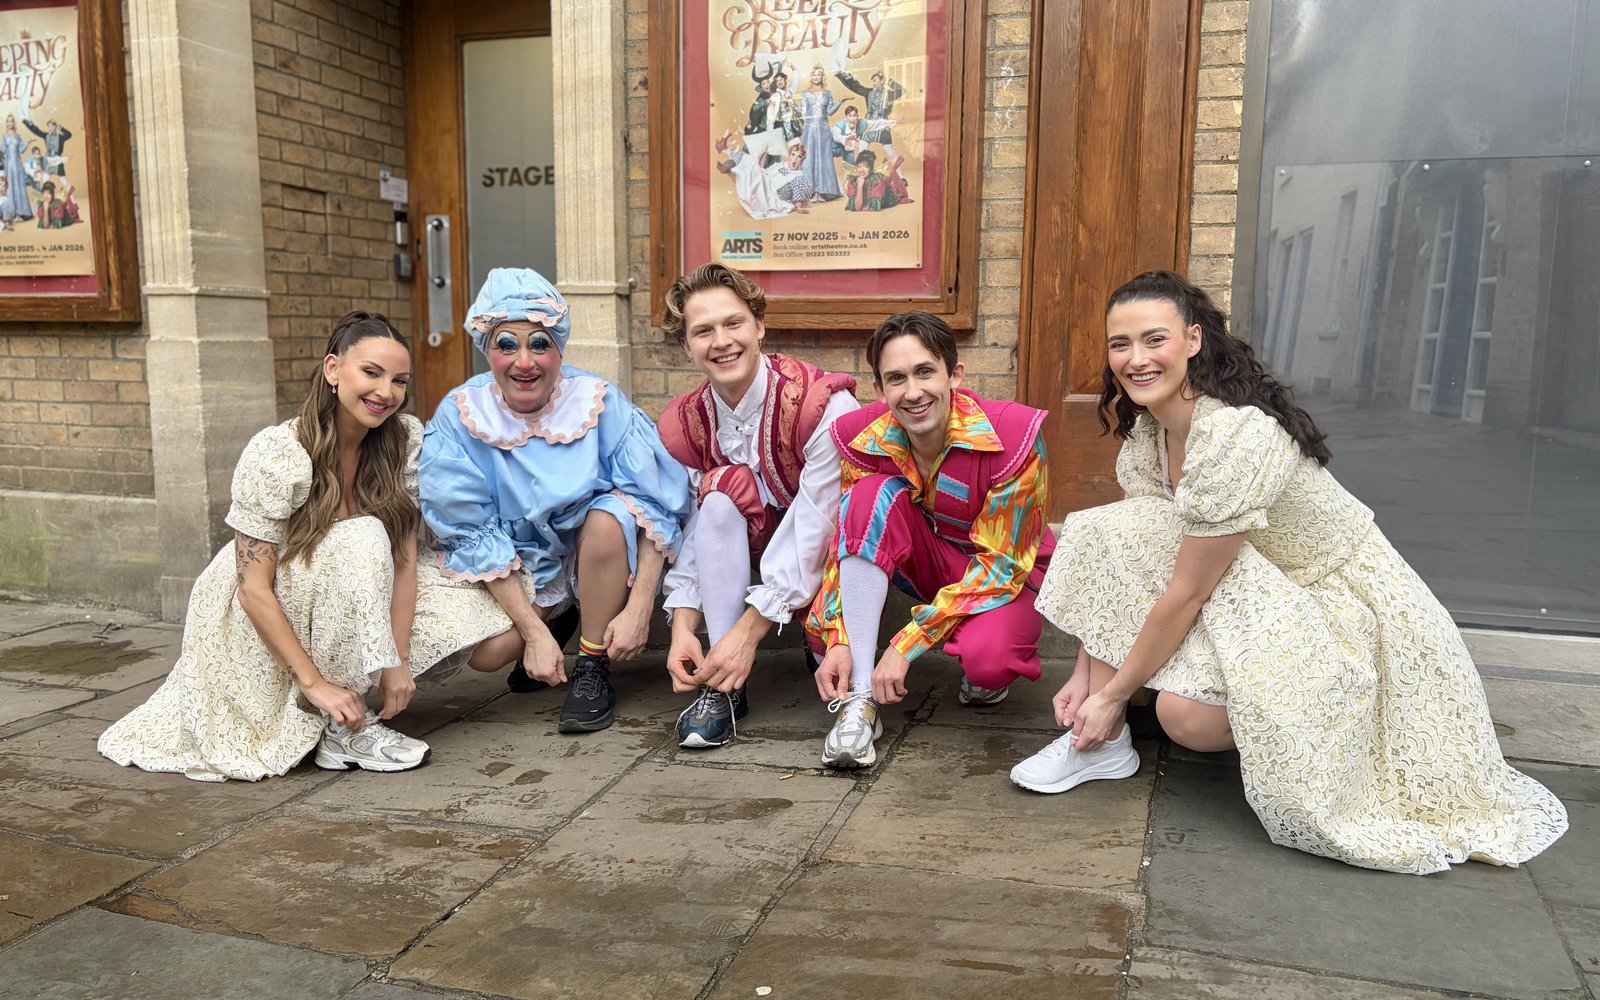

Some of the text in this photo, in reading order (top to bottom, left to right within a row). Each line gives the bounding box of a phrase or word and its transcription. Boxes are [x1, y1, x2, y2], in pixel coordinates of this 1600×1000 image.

[730, 4, 889, 68] BEAUTY
[481, 166, 555, 188] STAGE
[773, 233, 785, 242] 27
[788, 232, 809, 241] NOV
[812, 232, 838, 241] 2025
[849, 231, 856, 240] 4
[858, 230, 880, 240] JAN
[882, 230, 910, 239] 2026
[65, 243, 84, 252] 2026
[721, 238, 763, 253] ARTS
